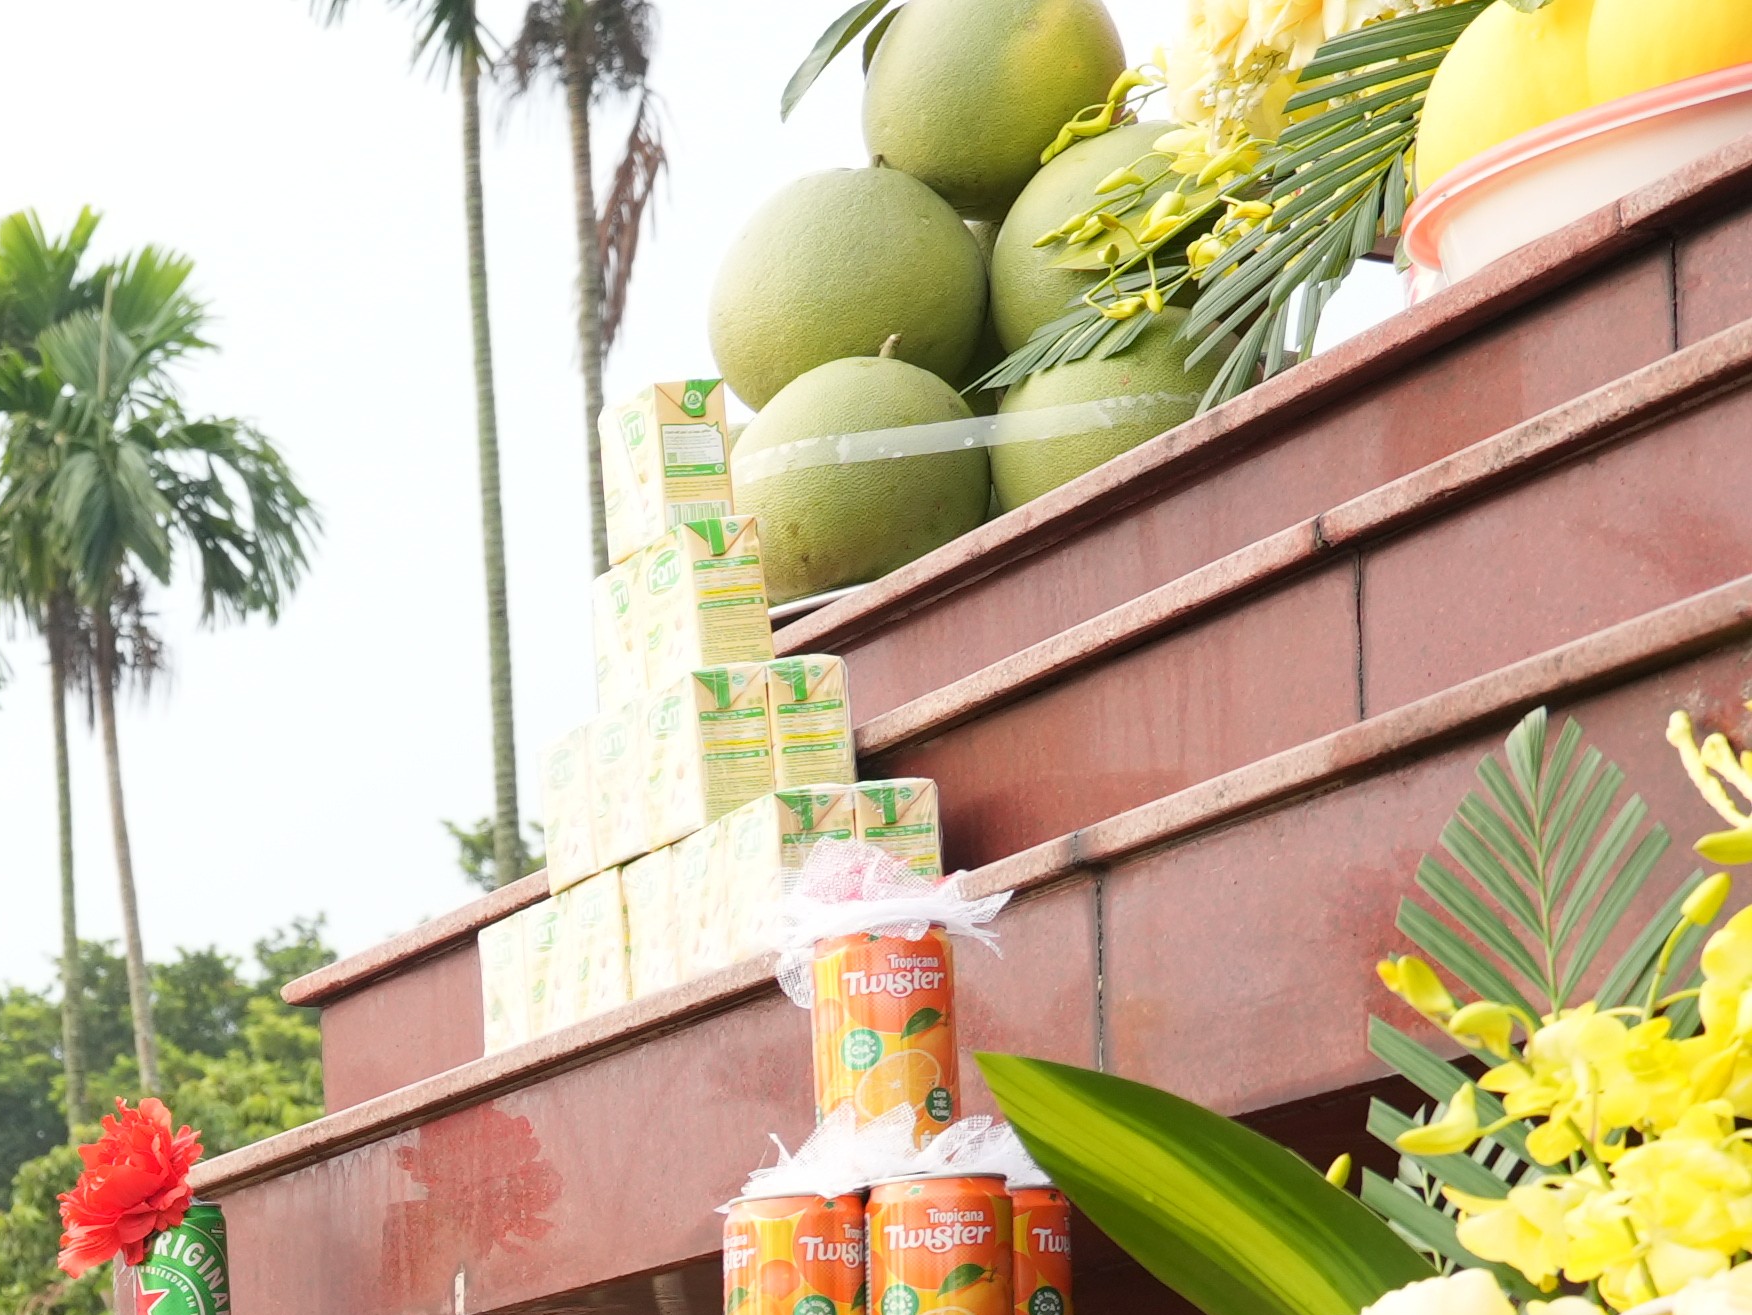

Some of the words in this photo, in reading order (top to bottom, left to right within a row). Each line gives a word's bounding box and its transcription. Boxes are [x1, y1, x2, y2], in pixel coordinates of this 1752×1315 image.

[887, 953, 939, 970] Tropicana
[841, 966, 945, 998] Twister
[927, 1208, 984, 1224] Tropicana
[884, 1224, 992, 1253] Twister
[140, 1266, 189, 1295] MSTERDAM
